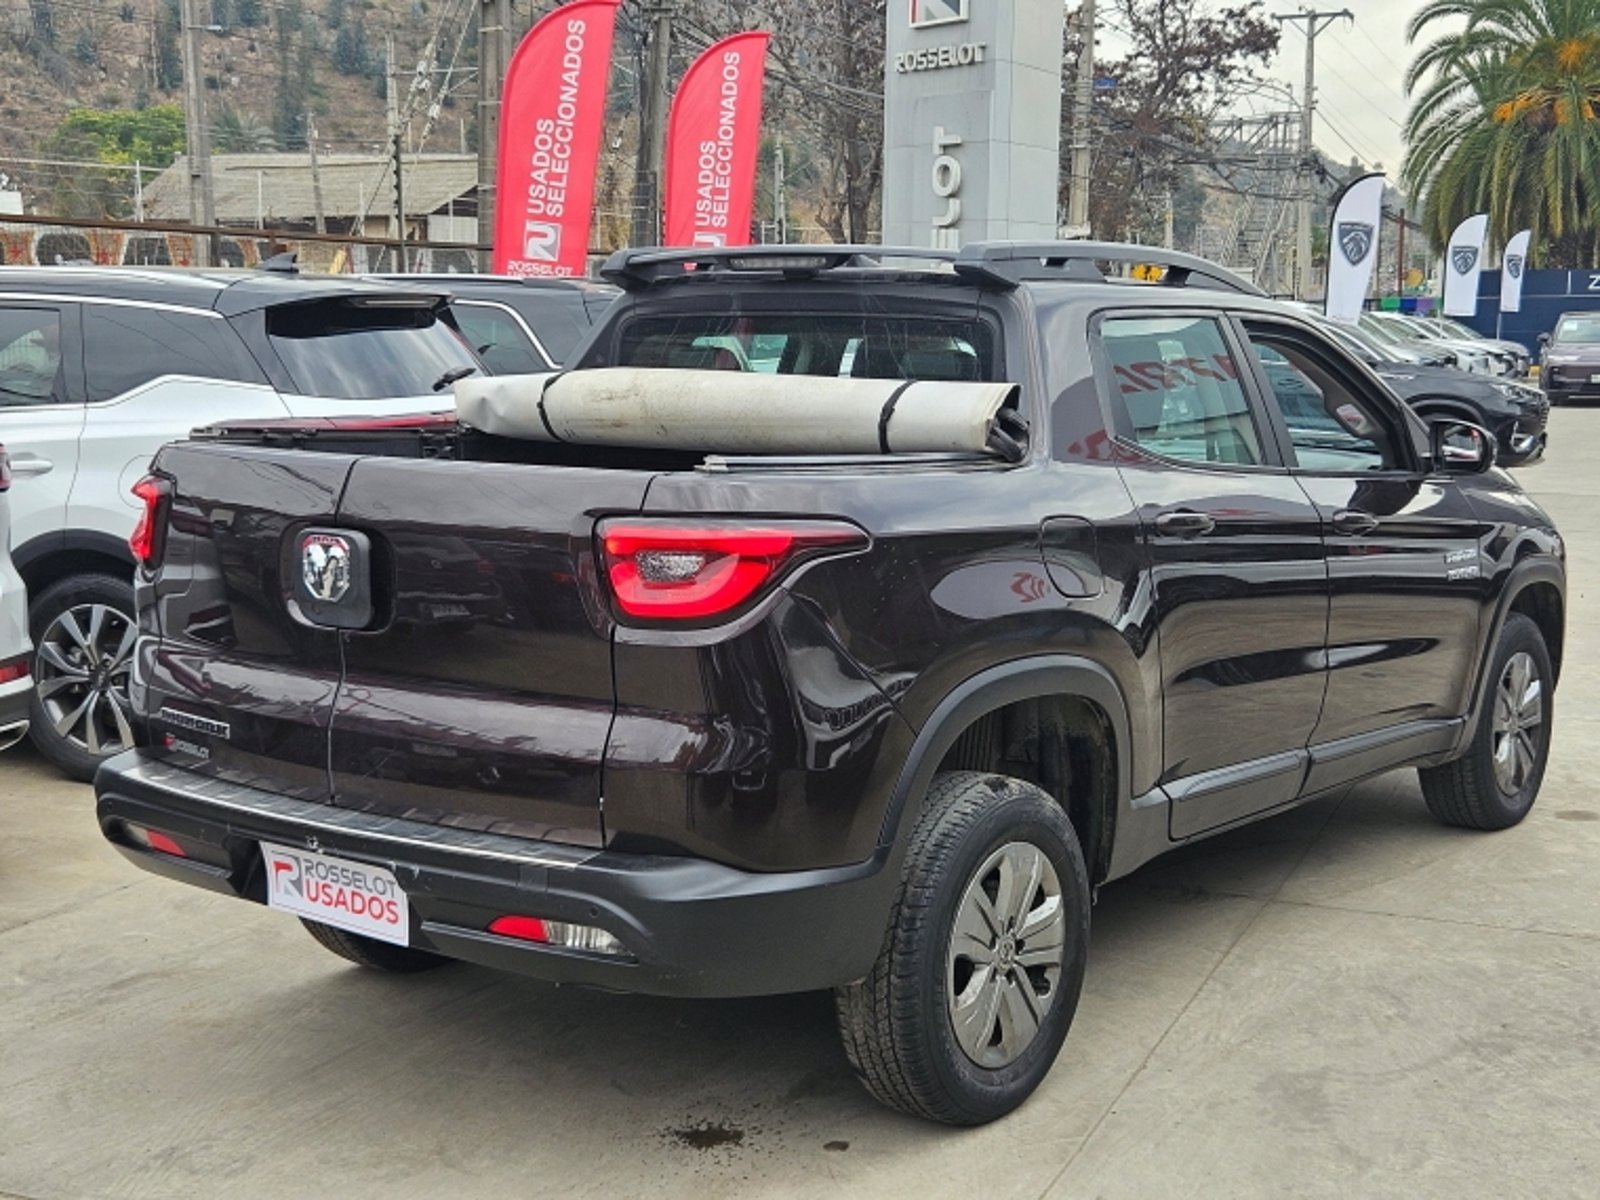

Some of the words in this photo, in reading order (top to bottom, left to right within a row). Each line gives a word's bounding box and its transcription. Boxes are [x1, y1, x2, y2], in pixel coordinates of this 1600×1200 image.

[894, 42, 987, 73] ROSSELOT
[547, 19, 586, 217] SELECCIONADOS
[712, 51, 740, 227] SELECCIONADOS
[528, 119, 555, 214] USADOS
[695, 140, 717, 226] USADOS
[303, 858, 396, 898] ROSSELOT
[305, 878, 399, 924] USADOS
